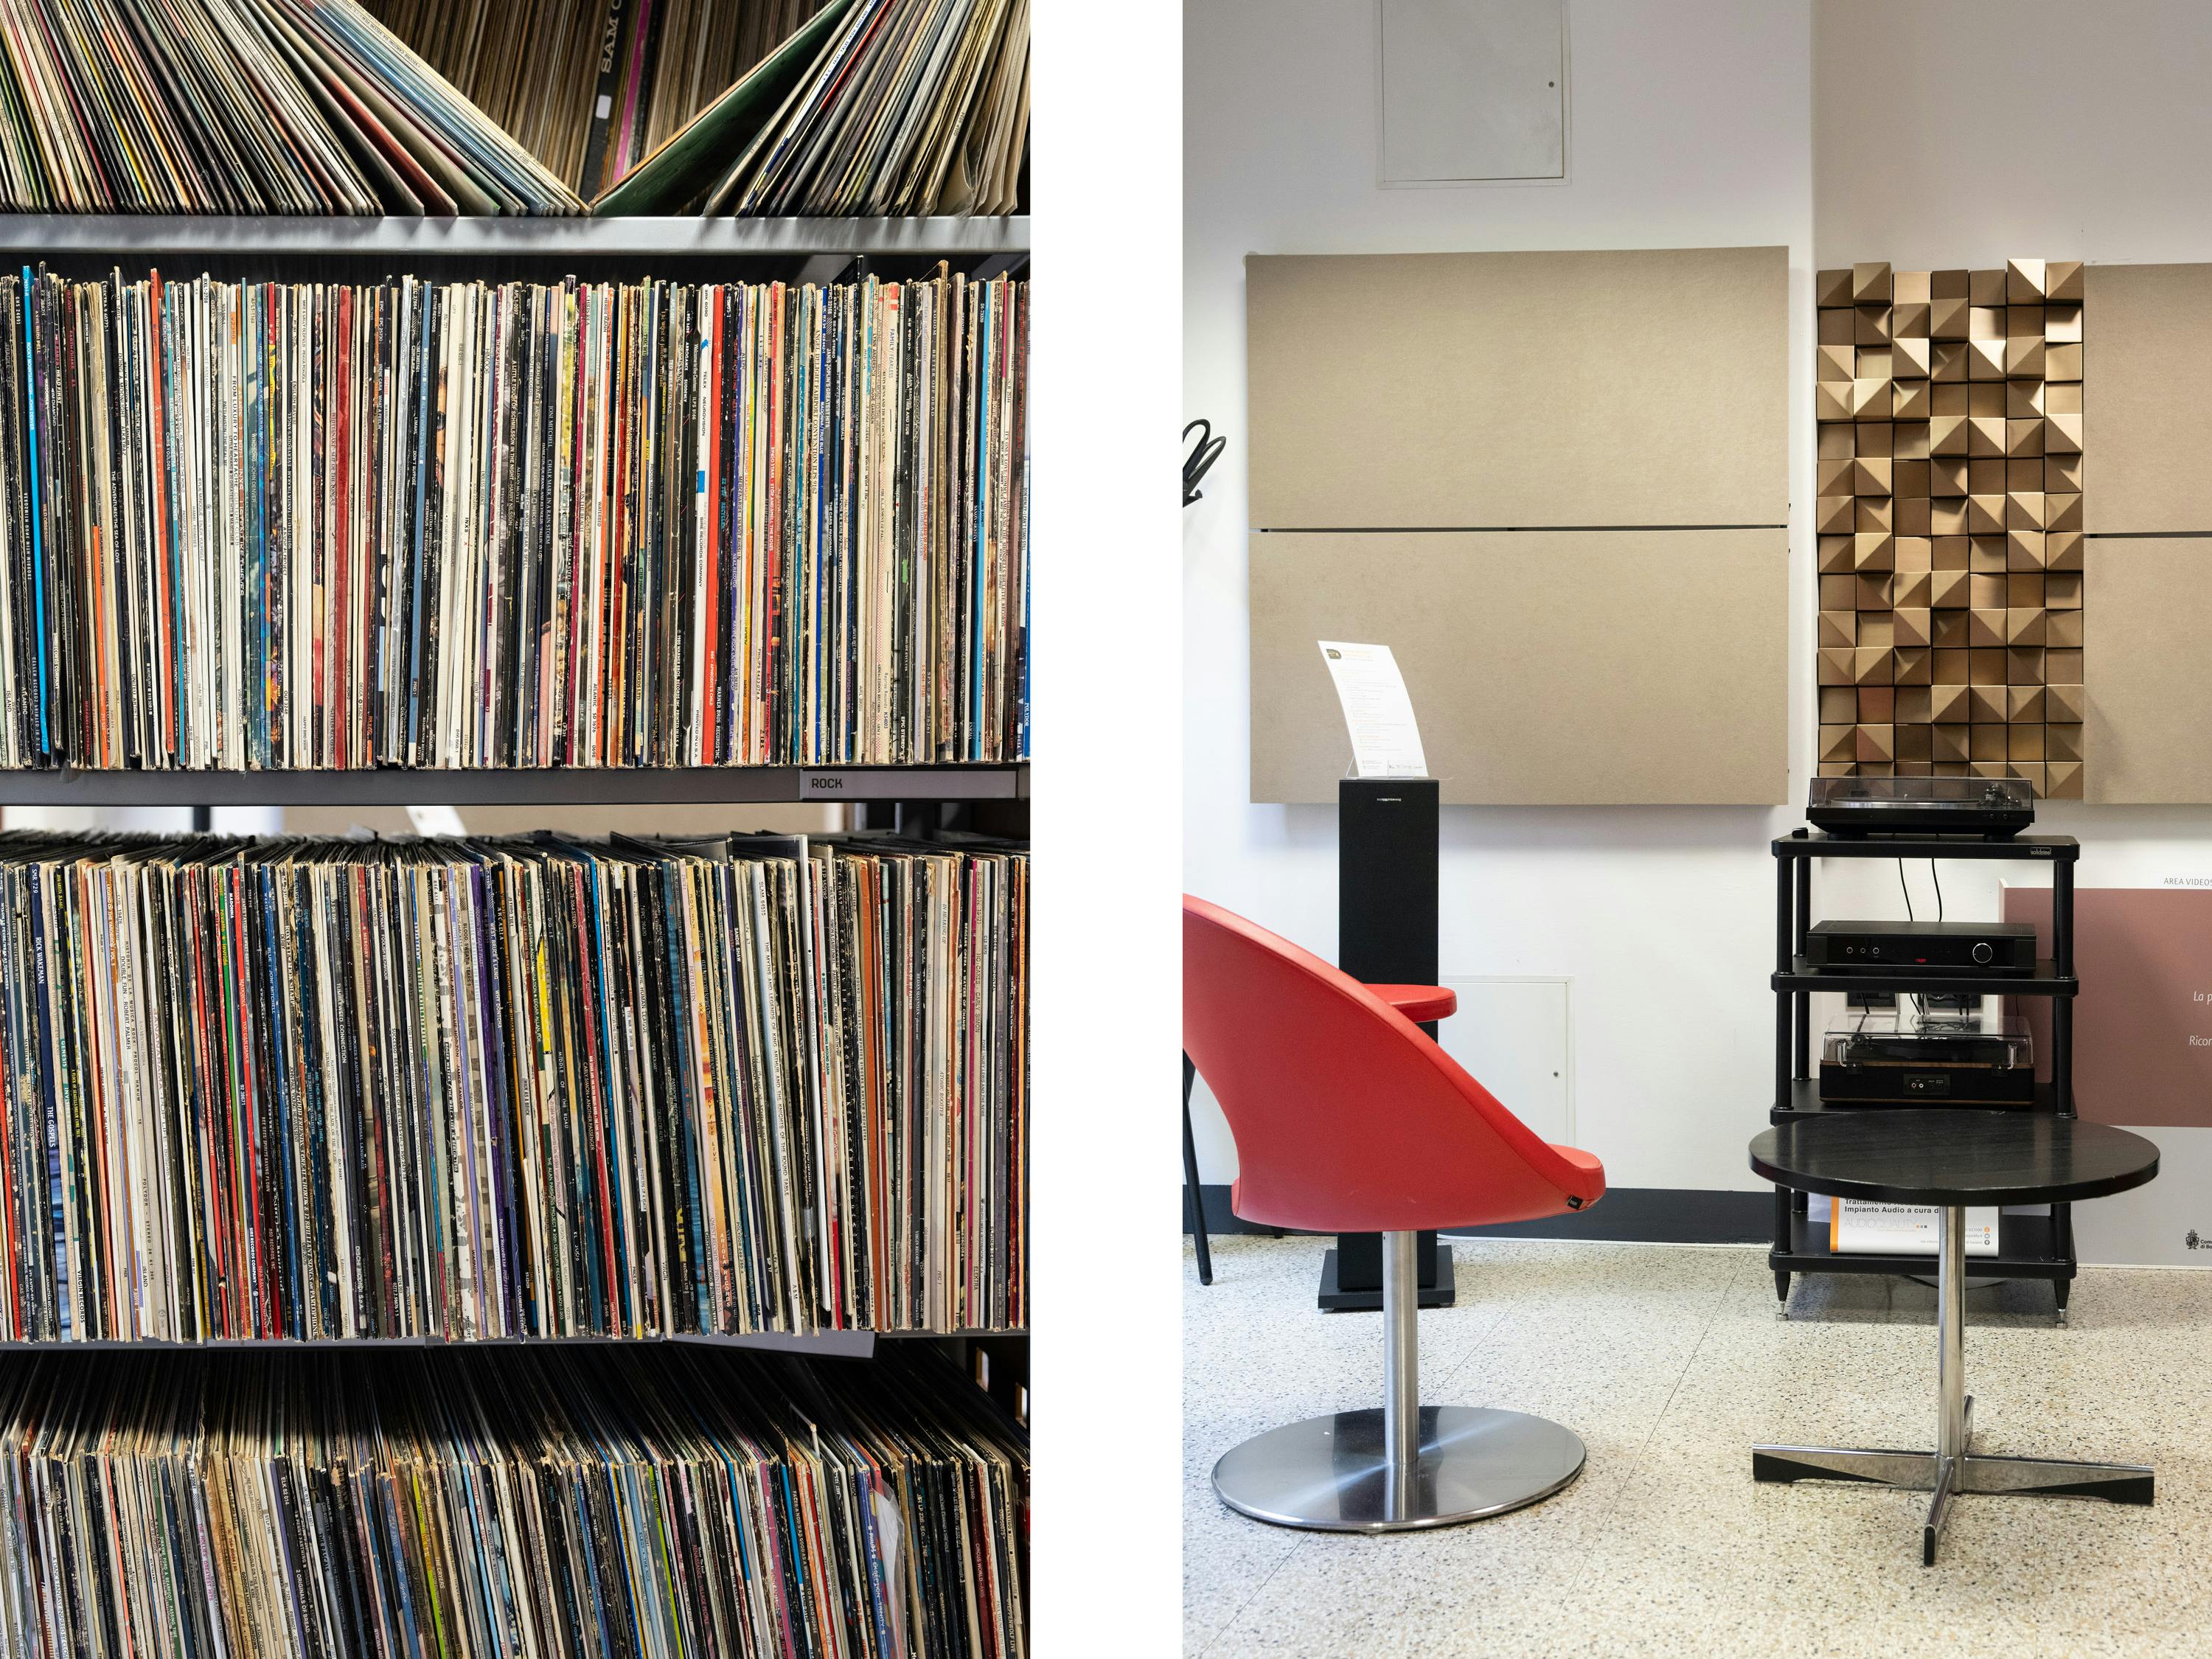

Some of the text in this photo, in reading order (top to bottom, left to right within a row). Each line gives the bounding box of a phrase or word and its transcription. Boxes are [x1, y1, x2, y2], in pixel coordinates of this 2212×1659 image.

[600, 15, 619, 74] SAM
[811, 777, 843, 790] ROCK
[2030, 848, 2052, 856] solidsteel
[2163, 877, 2184, 886] AREA
[36, 952, 44, 984] WAKEMAN
[2194, 990, 2204, 1001] La
[771, 1022, 776, 1031] OF
[780, 1131, 785, 1140] OF
[48, 1119, 56, 1147] GOSPELS
[320, 1545, 330, 1572] RASCALS
[296, 1573, 306, 1604] ORIGINALS
[437, 1568, 445, 1589] CRYERS
